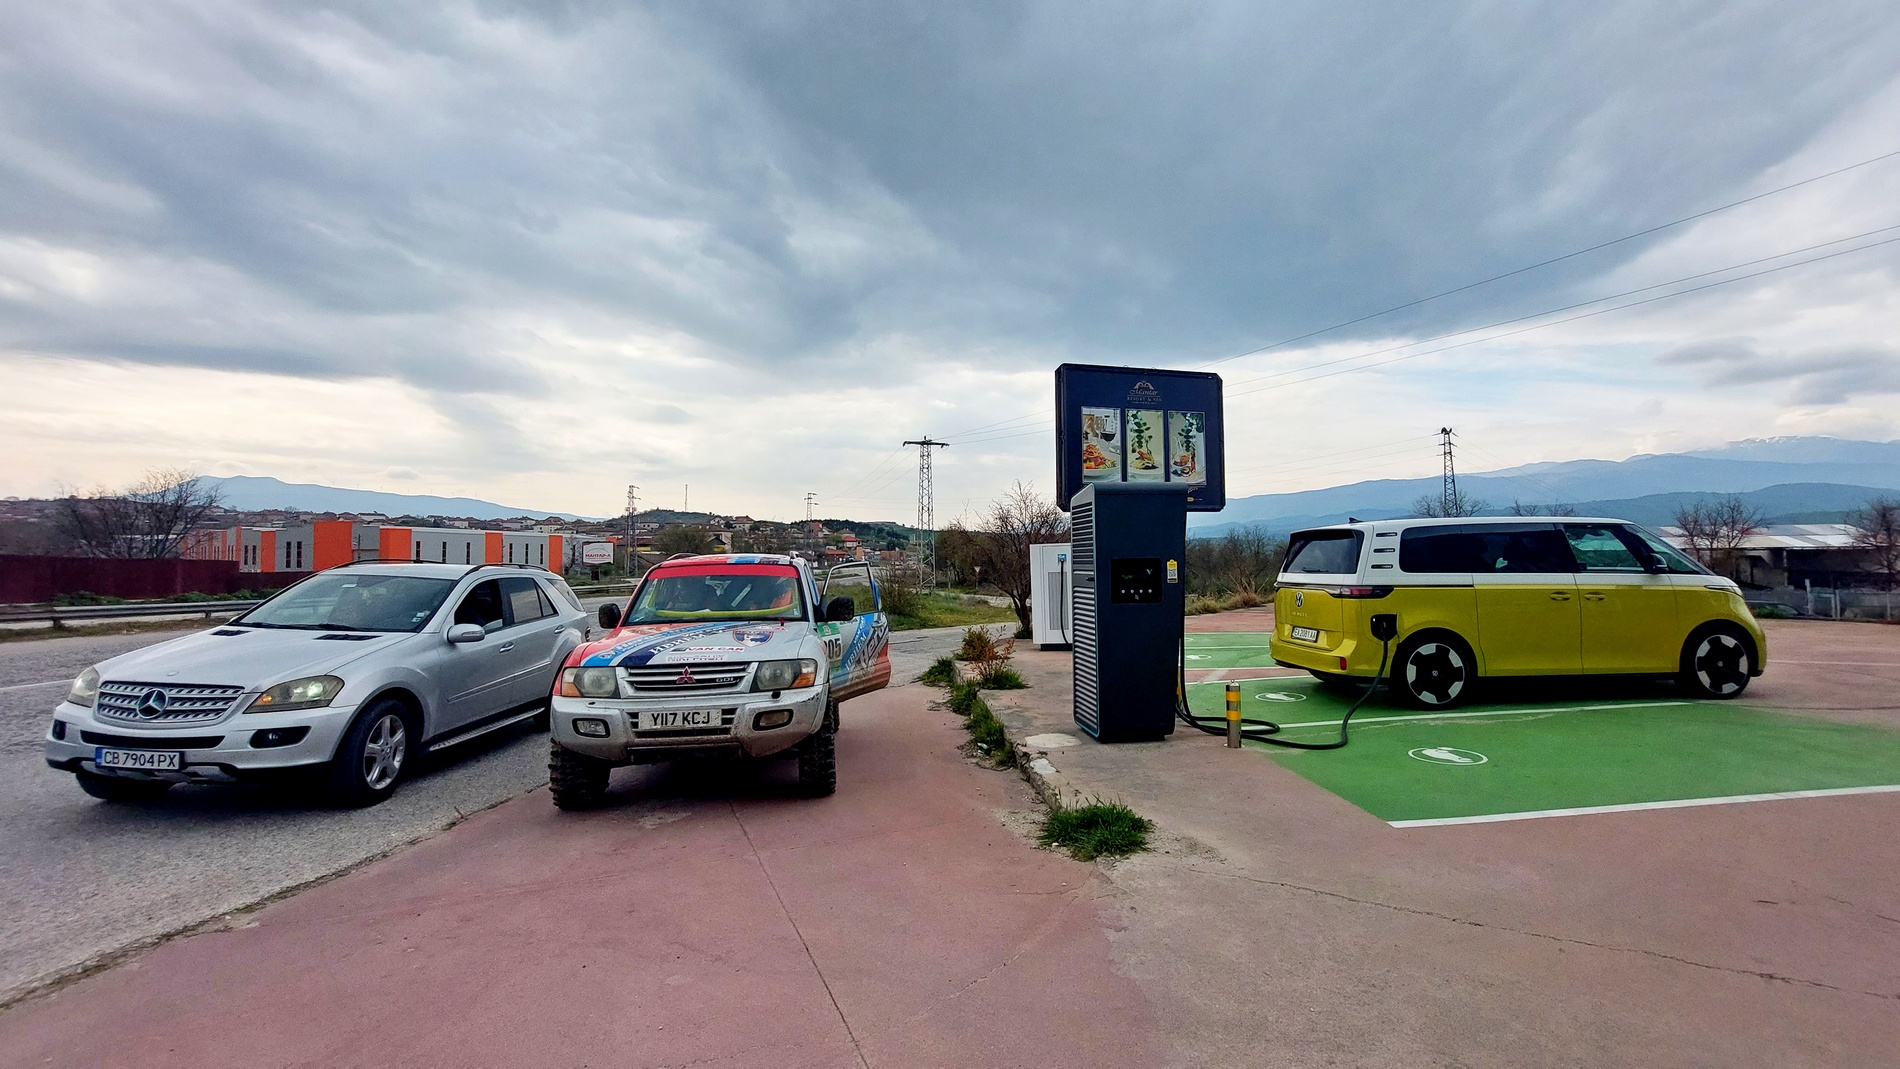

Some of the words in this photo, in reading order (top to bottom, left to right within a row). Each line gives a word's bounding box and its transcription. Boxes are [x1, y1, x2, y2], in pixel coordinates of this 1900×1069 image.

[651, 713, 678, 726] Y117
[682, 711, 710, 725] KCJ
[122, 752, 155, 767] 7904
[158, 754, 177, 767] PX
